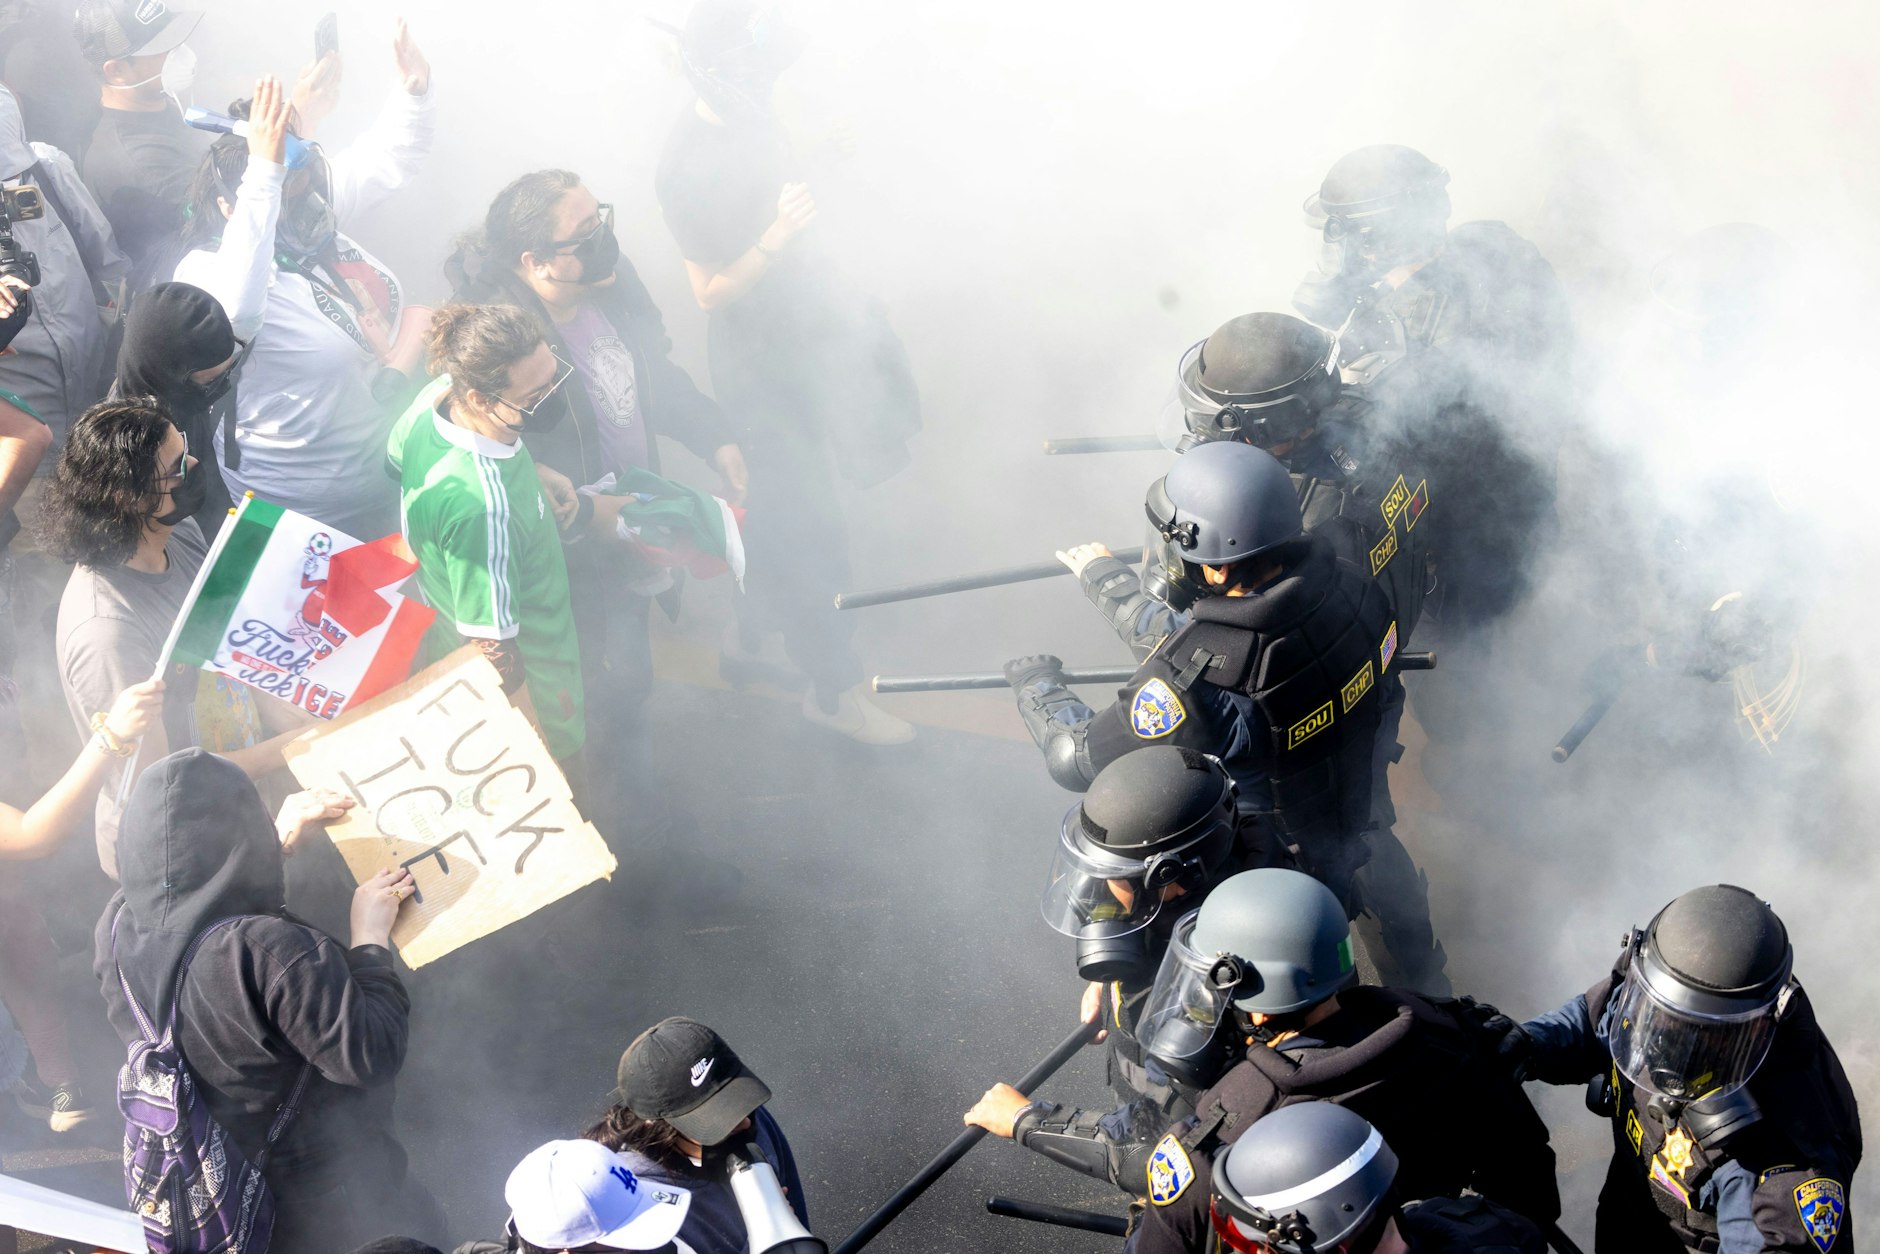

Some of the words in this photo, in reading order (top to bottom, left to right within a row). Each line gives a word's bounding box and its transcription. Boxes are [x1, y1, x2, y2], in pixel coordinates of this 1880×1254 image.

[1385, 484, 1405, 518] SOU
[1375, 535, 1394, 566] CHP
[238, 668, 297, 698] uck
[291, 677, 346, 721] ICE
[1346, 670, 1370, 703] CHP
[1294, 709, 1328, 741] SOU
[417, 678, 565, 875] FUCK
[339, 737, 487, 904] ICE
[690, 1057, 709, 1079] NIKE
[610, 1166, 638, 1195] LA
